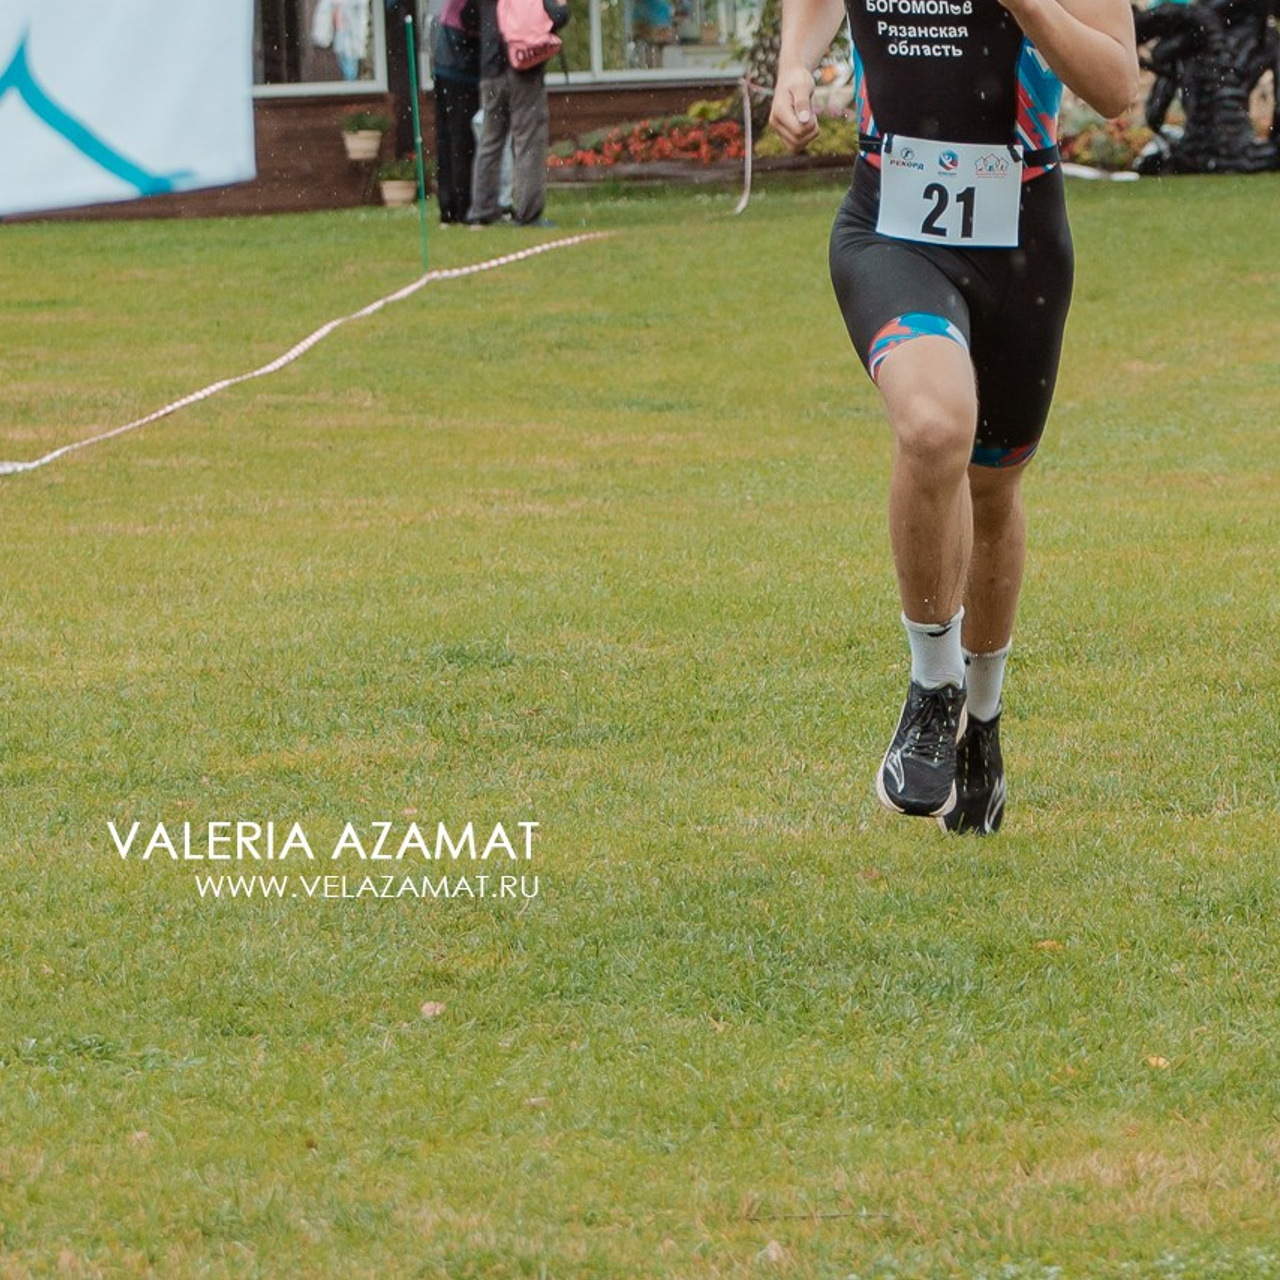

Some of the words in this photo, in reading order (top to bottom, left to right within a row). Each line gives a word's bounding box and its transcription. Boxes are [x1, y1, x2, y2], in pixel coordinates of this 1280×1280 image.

[877, 20, 969, 38] Рязанская
[888, 39, 963, 57] область
[921, 182, 976, 238] 21
